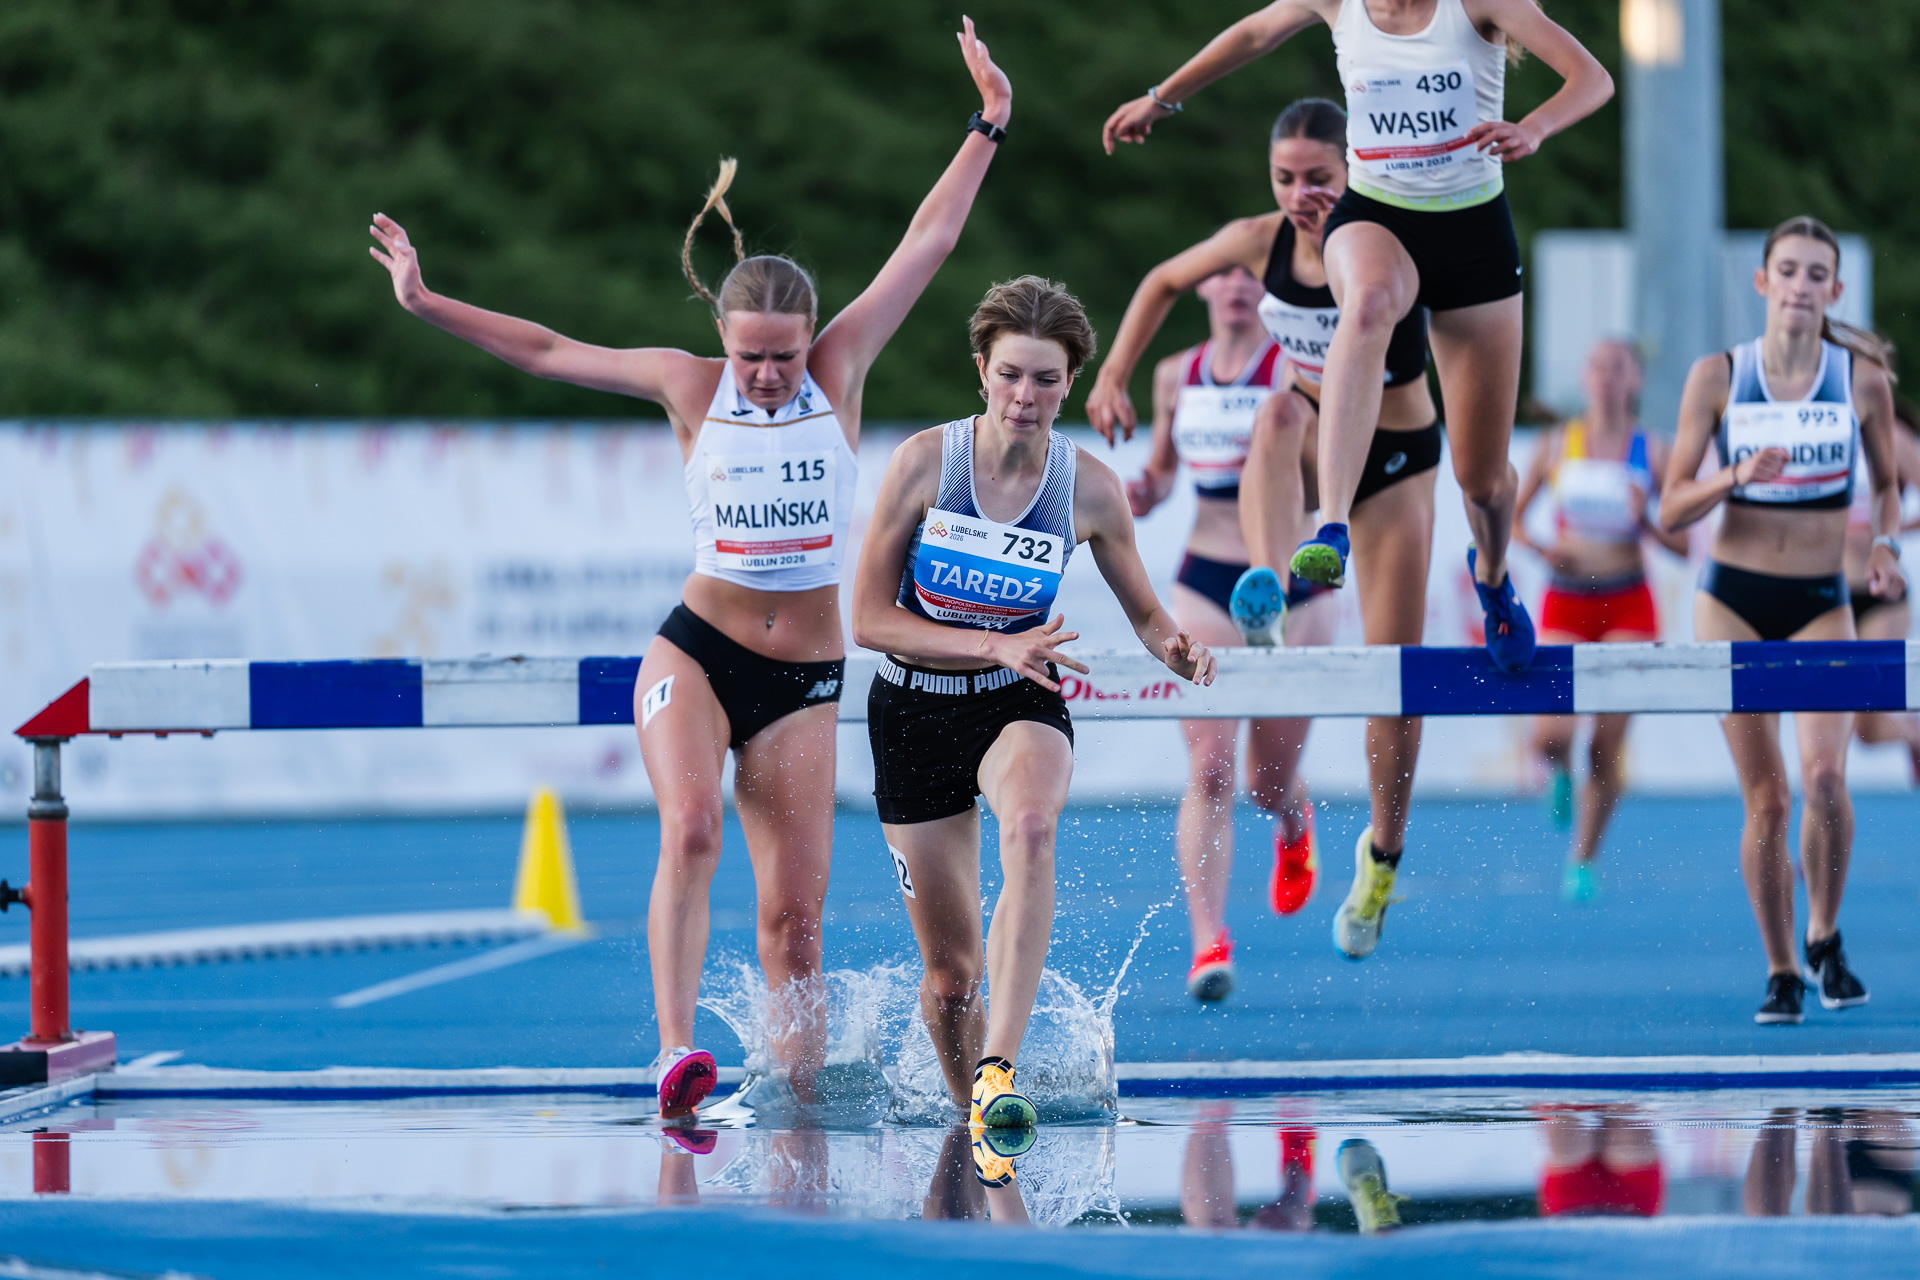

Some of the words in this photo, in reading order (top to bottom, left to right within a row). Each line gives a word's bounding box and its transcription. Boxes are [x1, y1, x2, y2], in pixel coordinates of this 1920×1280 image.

[1416, 71, 1462, 93] 430
[1368, 107, 1458, 139] WĄSIK
[1798, 406, 1838, 428] 995
[1734, 442, 1844, 465] ODER
[781, 459, 825, 483] 115
[715, 497, 829, 528] MALIŃSKA
[949, 533, 964, 542] 2026
[950, 524, 989, 540] LUBELSKIE
[1002, 532, 1053, 564] 732
[741, 557, 778, 568] LUBLIN
[780, 554, 806, 565] 2026
[930, 559, 1043, 604] TARĘDŹ
[936, 609, 977, 621] LUBLIN
[979, 614, 1009, 622] 2026
[877, 657, 907, 687] UMA
[909, 671, 968, 695] PUMA
[973, 667, 1025, 694] PUM
[890, 851, 913, 892] 2
